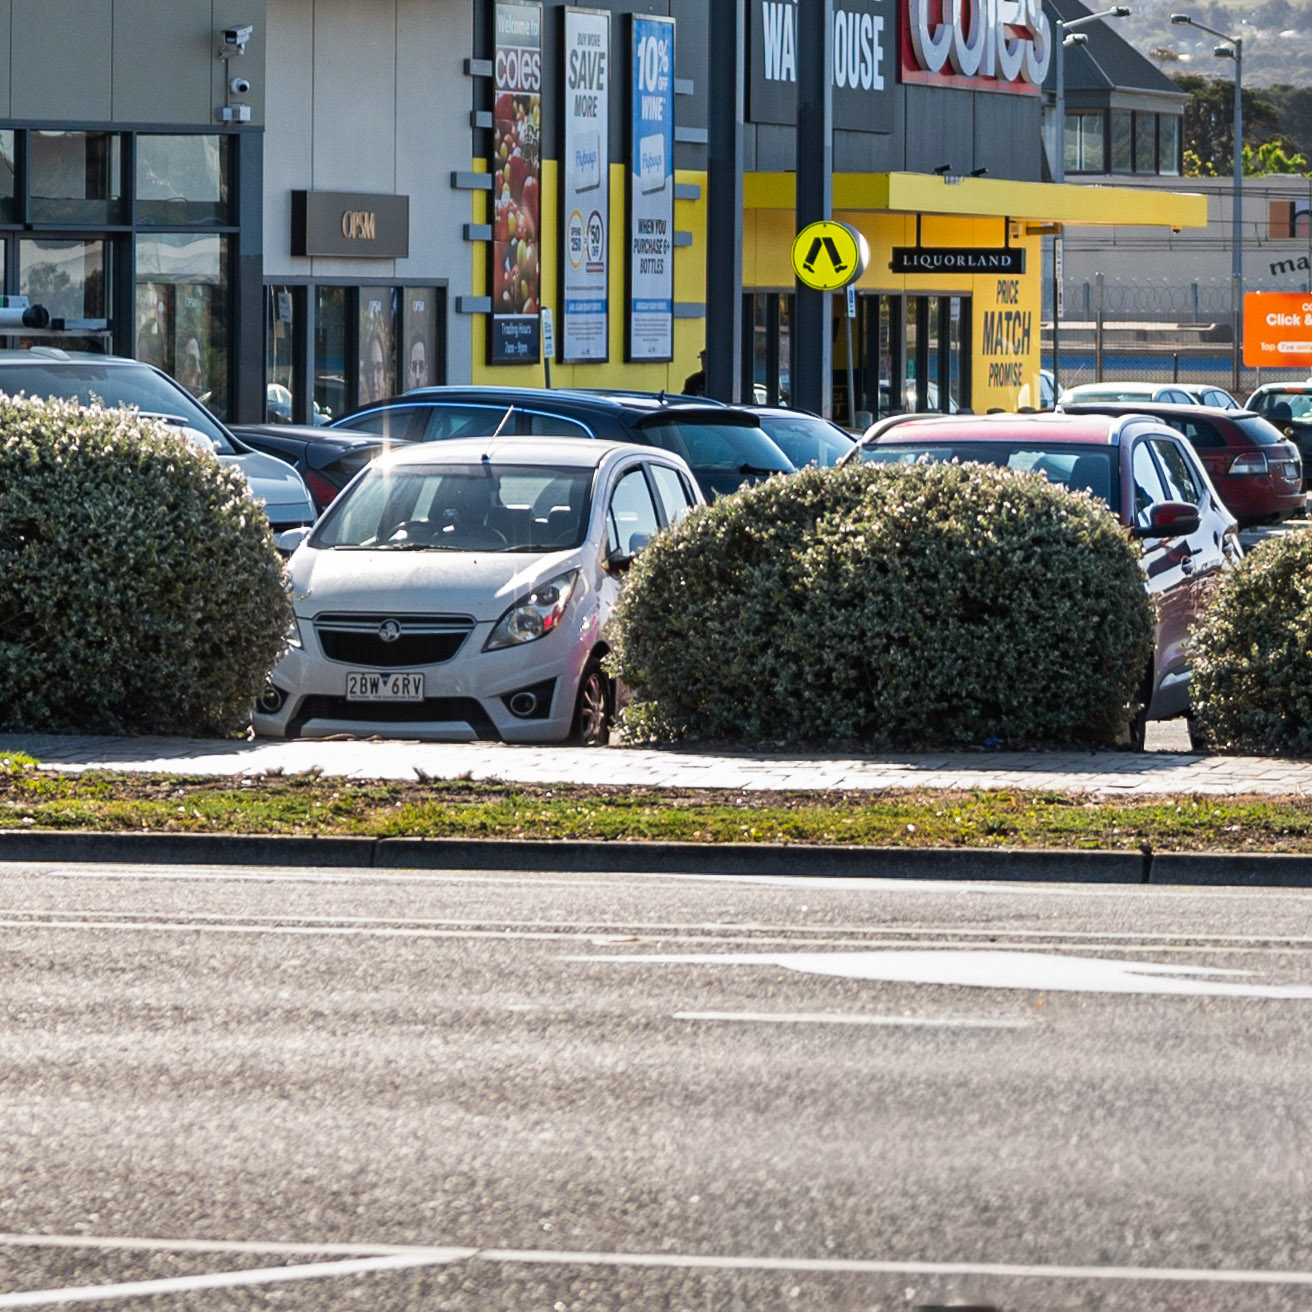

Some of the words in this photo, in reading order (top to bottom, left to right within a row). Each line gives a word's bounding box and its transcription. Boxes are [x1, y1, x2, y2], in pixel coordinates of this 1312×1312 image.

[497, 14, 530, 35] Welcome
[531, 20, 538, 35] to
[762, 1, 884, 91] WAOUSE
[496, 48, 540, 90] coles
[568, 49, 605, 90] SAVE
[638, 36, 668, 92] 10%
[658, 77, 668, 91] OFF
[574, 95, 598, 118] MORE
[342, 210, 376, 239] OPSM
[638, 218, 654, 234] WHEN
[655, 220, 666, 235] YOU
[634, 238, 662, 255] PURCHASE
[640, 258, 664, 274] BOTTLES
[903, 255, 1012, 268] LIQUORLAND
[996, 280, 1019, 304] PRICE
[1266, 313, 1300, 326] Click
[982, 310, 1031, 355] MATCH
[1260, 342, 1275, 352] Tap
[988, 362, 1023, 387] PROMISE
[349, 677, 380, 694] 2BW
[391, 677, 422, 695] 6RV
